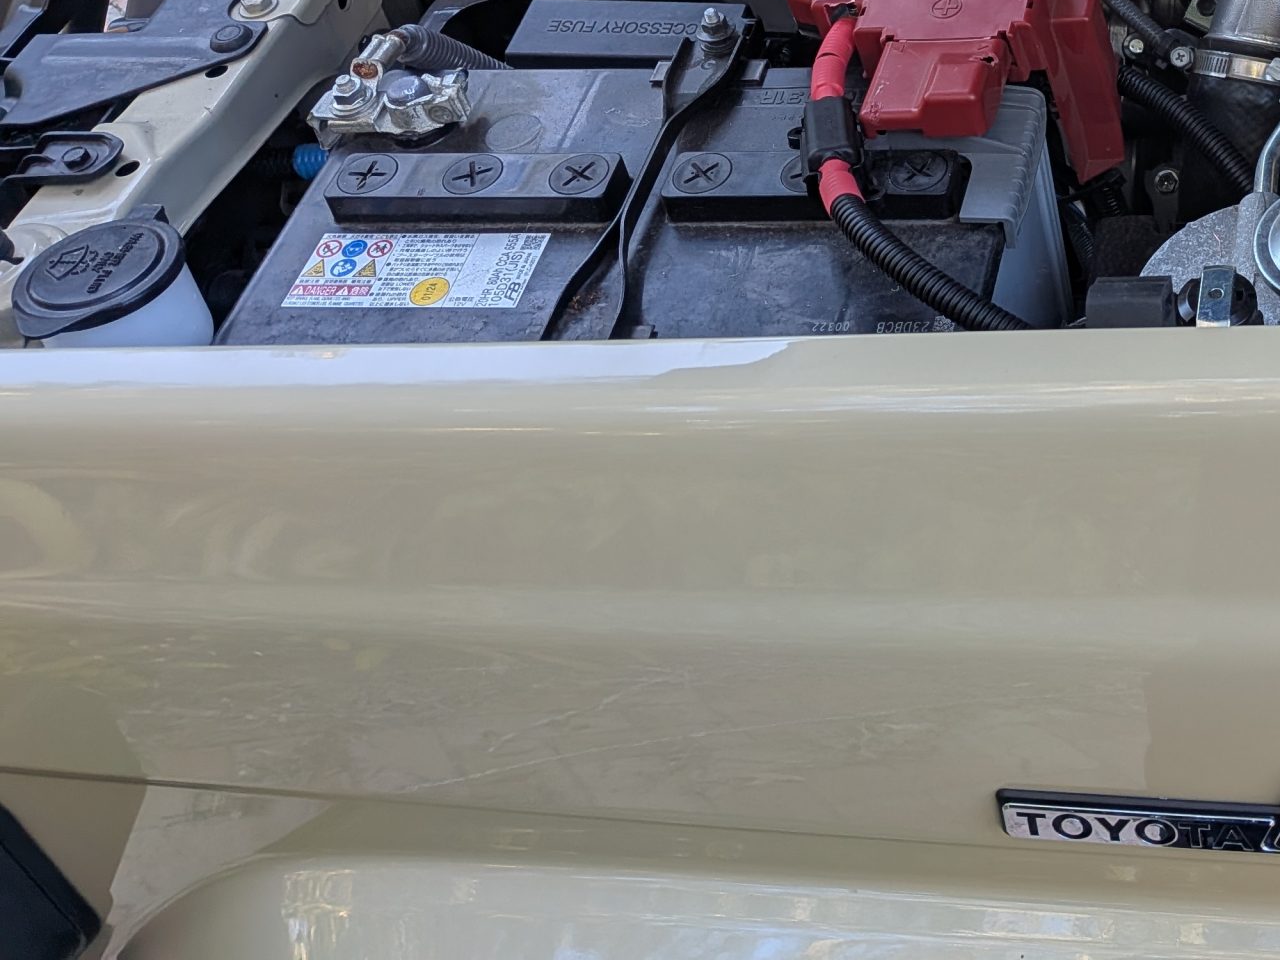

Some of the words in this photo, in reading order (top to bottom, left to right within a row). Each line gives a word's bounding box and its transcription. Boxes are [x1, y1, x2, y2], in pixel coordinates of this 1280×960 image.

[547, 20, 597, 33] FUSE
[598, 21, 697, 35] CCESSORY
[496, 252, 512, 266] CCA
[304, 286, 337, 296] DANGER
[811, 321, 850, 332] 00322
[876, 321, 930, 333] 23DBCB
[1015, 810, 1255, 851] TOYOTA
